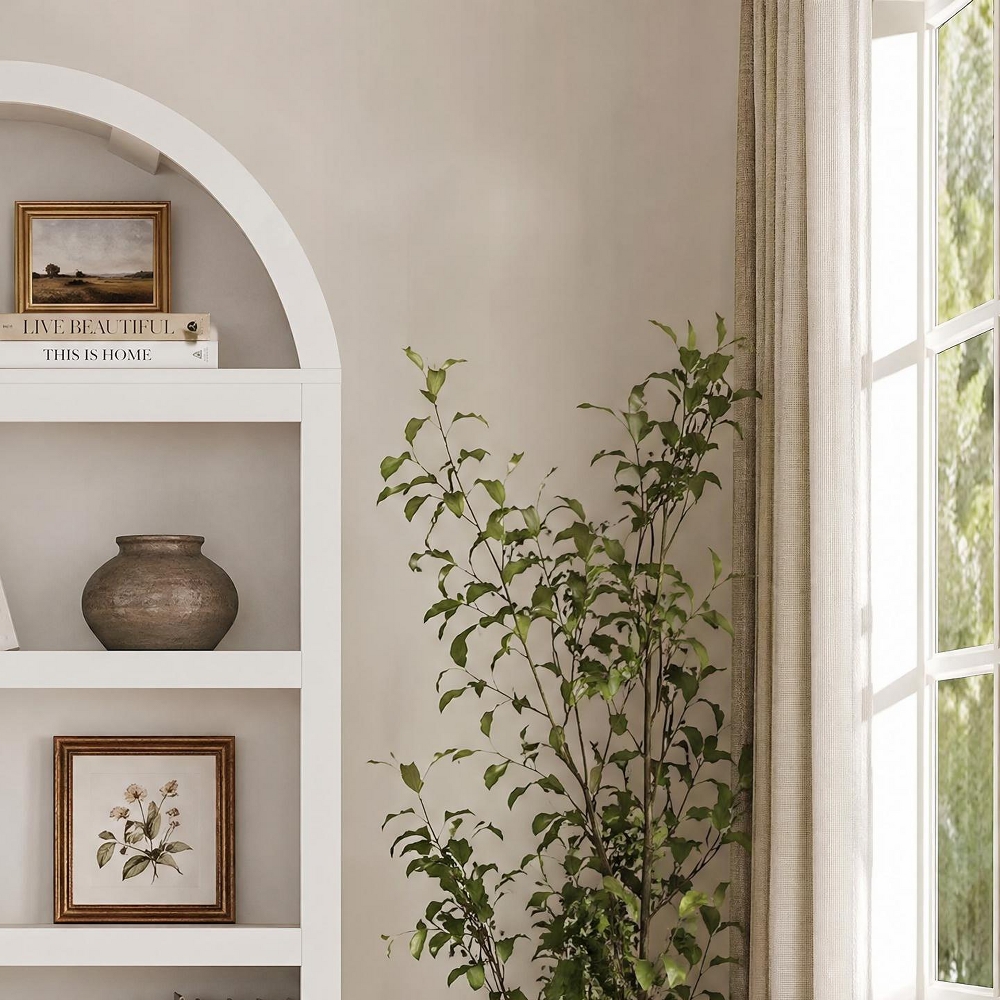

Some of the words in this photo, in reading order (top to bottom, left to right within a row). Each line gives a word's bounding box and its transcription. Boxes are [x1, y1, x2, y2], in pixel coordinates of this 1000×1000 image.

[23, 319, 65, 334] LIVE
[70, 319, 175, 334] BEAUTIFUL
[43, 349, 80, 361] THIS
[84, 349, 97, 361] IS
[103, 349, 152, 361] HOME
